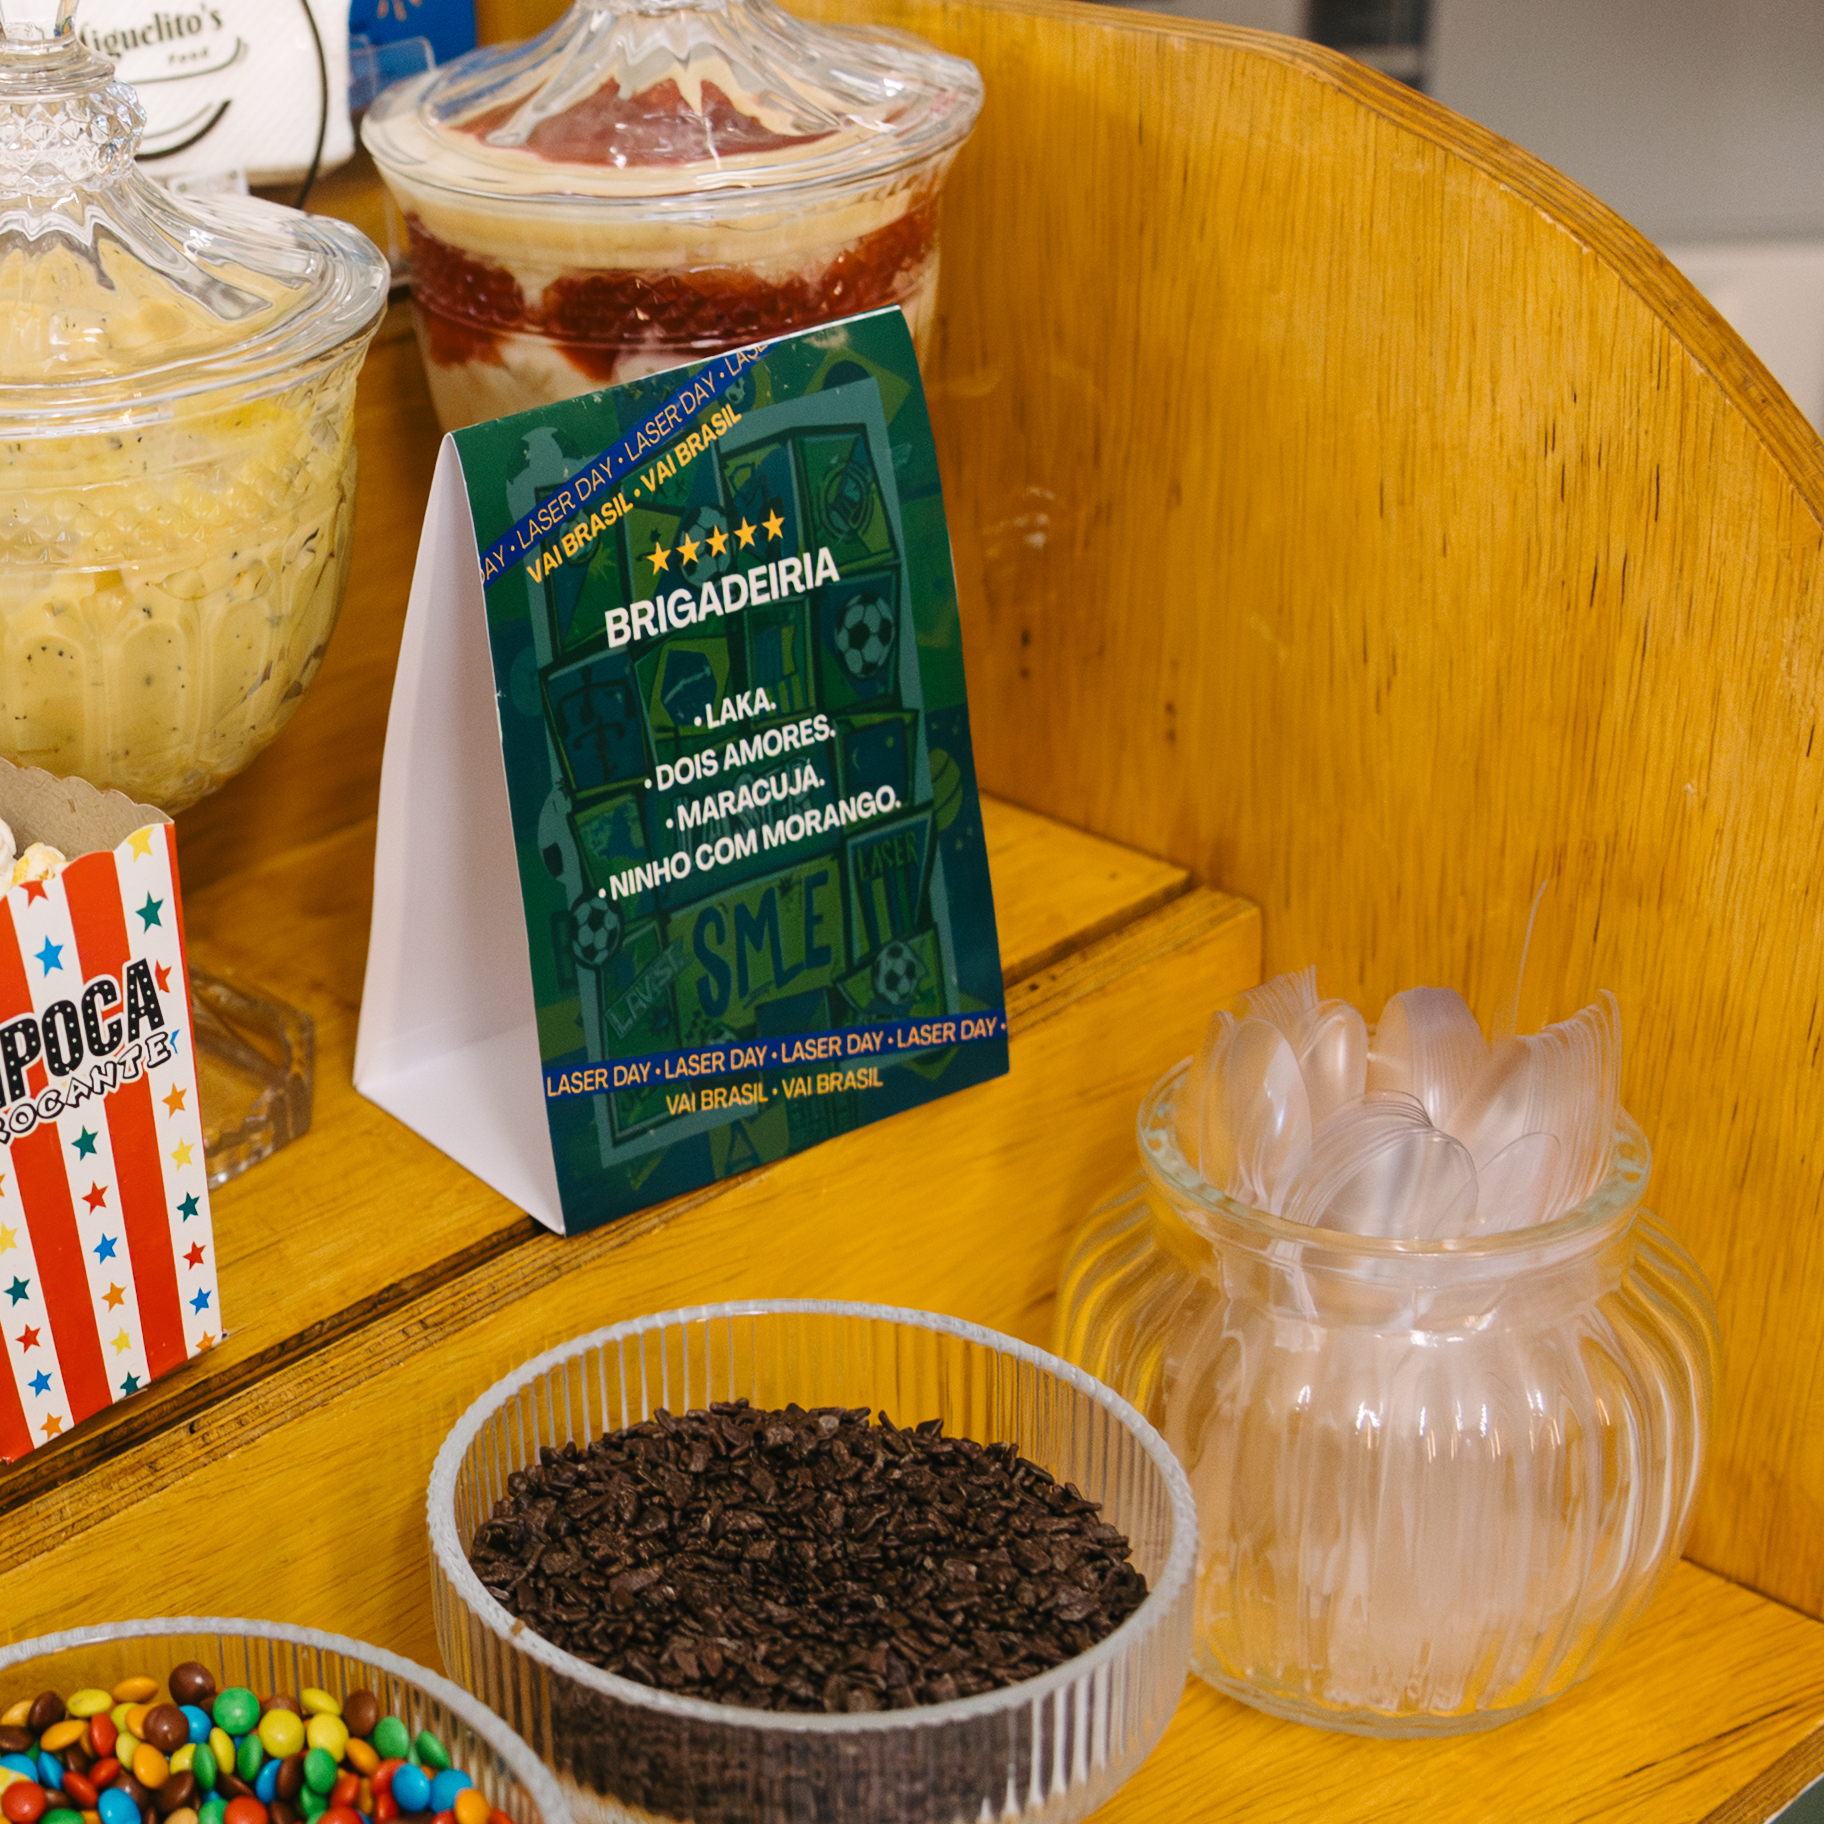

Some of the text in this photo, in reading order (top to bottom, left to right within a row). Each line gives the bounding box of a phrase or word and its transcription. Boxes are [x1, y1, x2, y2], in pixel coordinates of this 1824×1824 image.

[516, 489, 576, 550] LASER
[574, 456, 612, 502] DAY
[624, 403, 683, 462] LASER
[678, 370, 716, 415] DAY
[526, 402, 743, 584] VAI BRASIL VAI BRASIL
[604, 546, 840, 648] BRIGADEIRIA
[705, 687, 776, 729] LAKA.
[656, 714, 836, 792] DOIS AMORES.
[677, 757, 826, 831] MARACUJÁ.
[609, 784, 902, 901] NINHO COM MORANGO.
[546, 1016, 998, 1098] LASER DAY LASER DAY LASER DAY LASER DAY
[666, 1067, 884, 1117] VAI BRASIL VAI BRASIL
